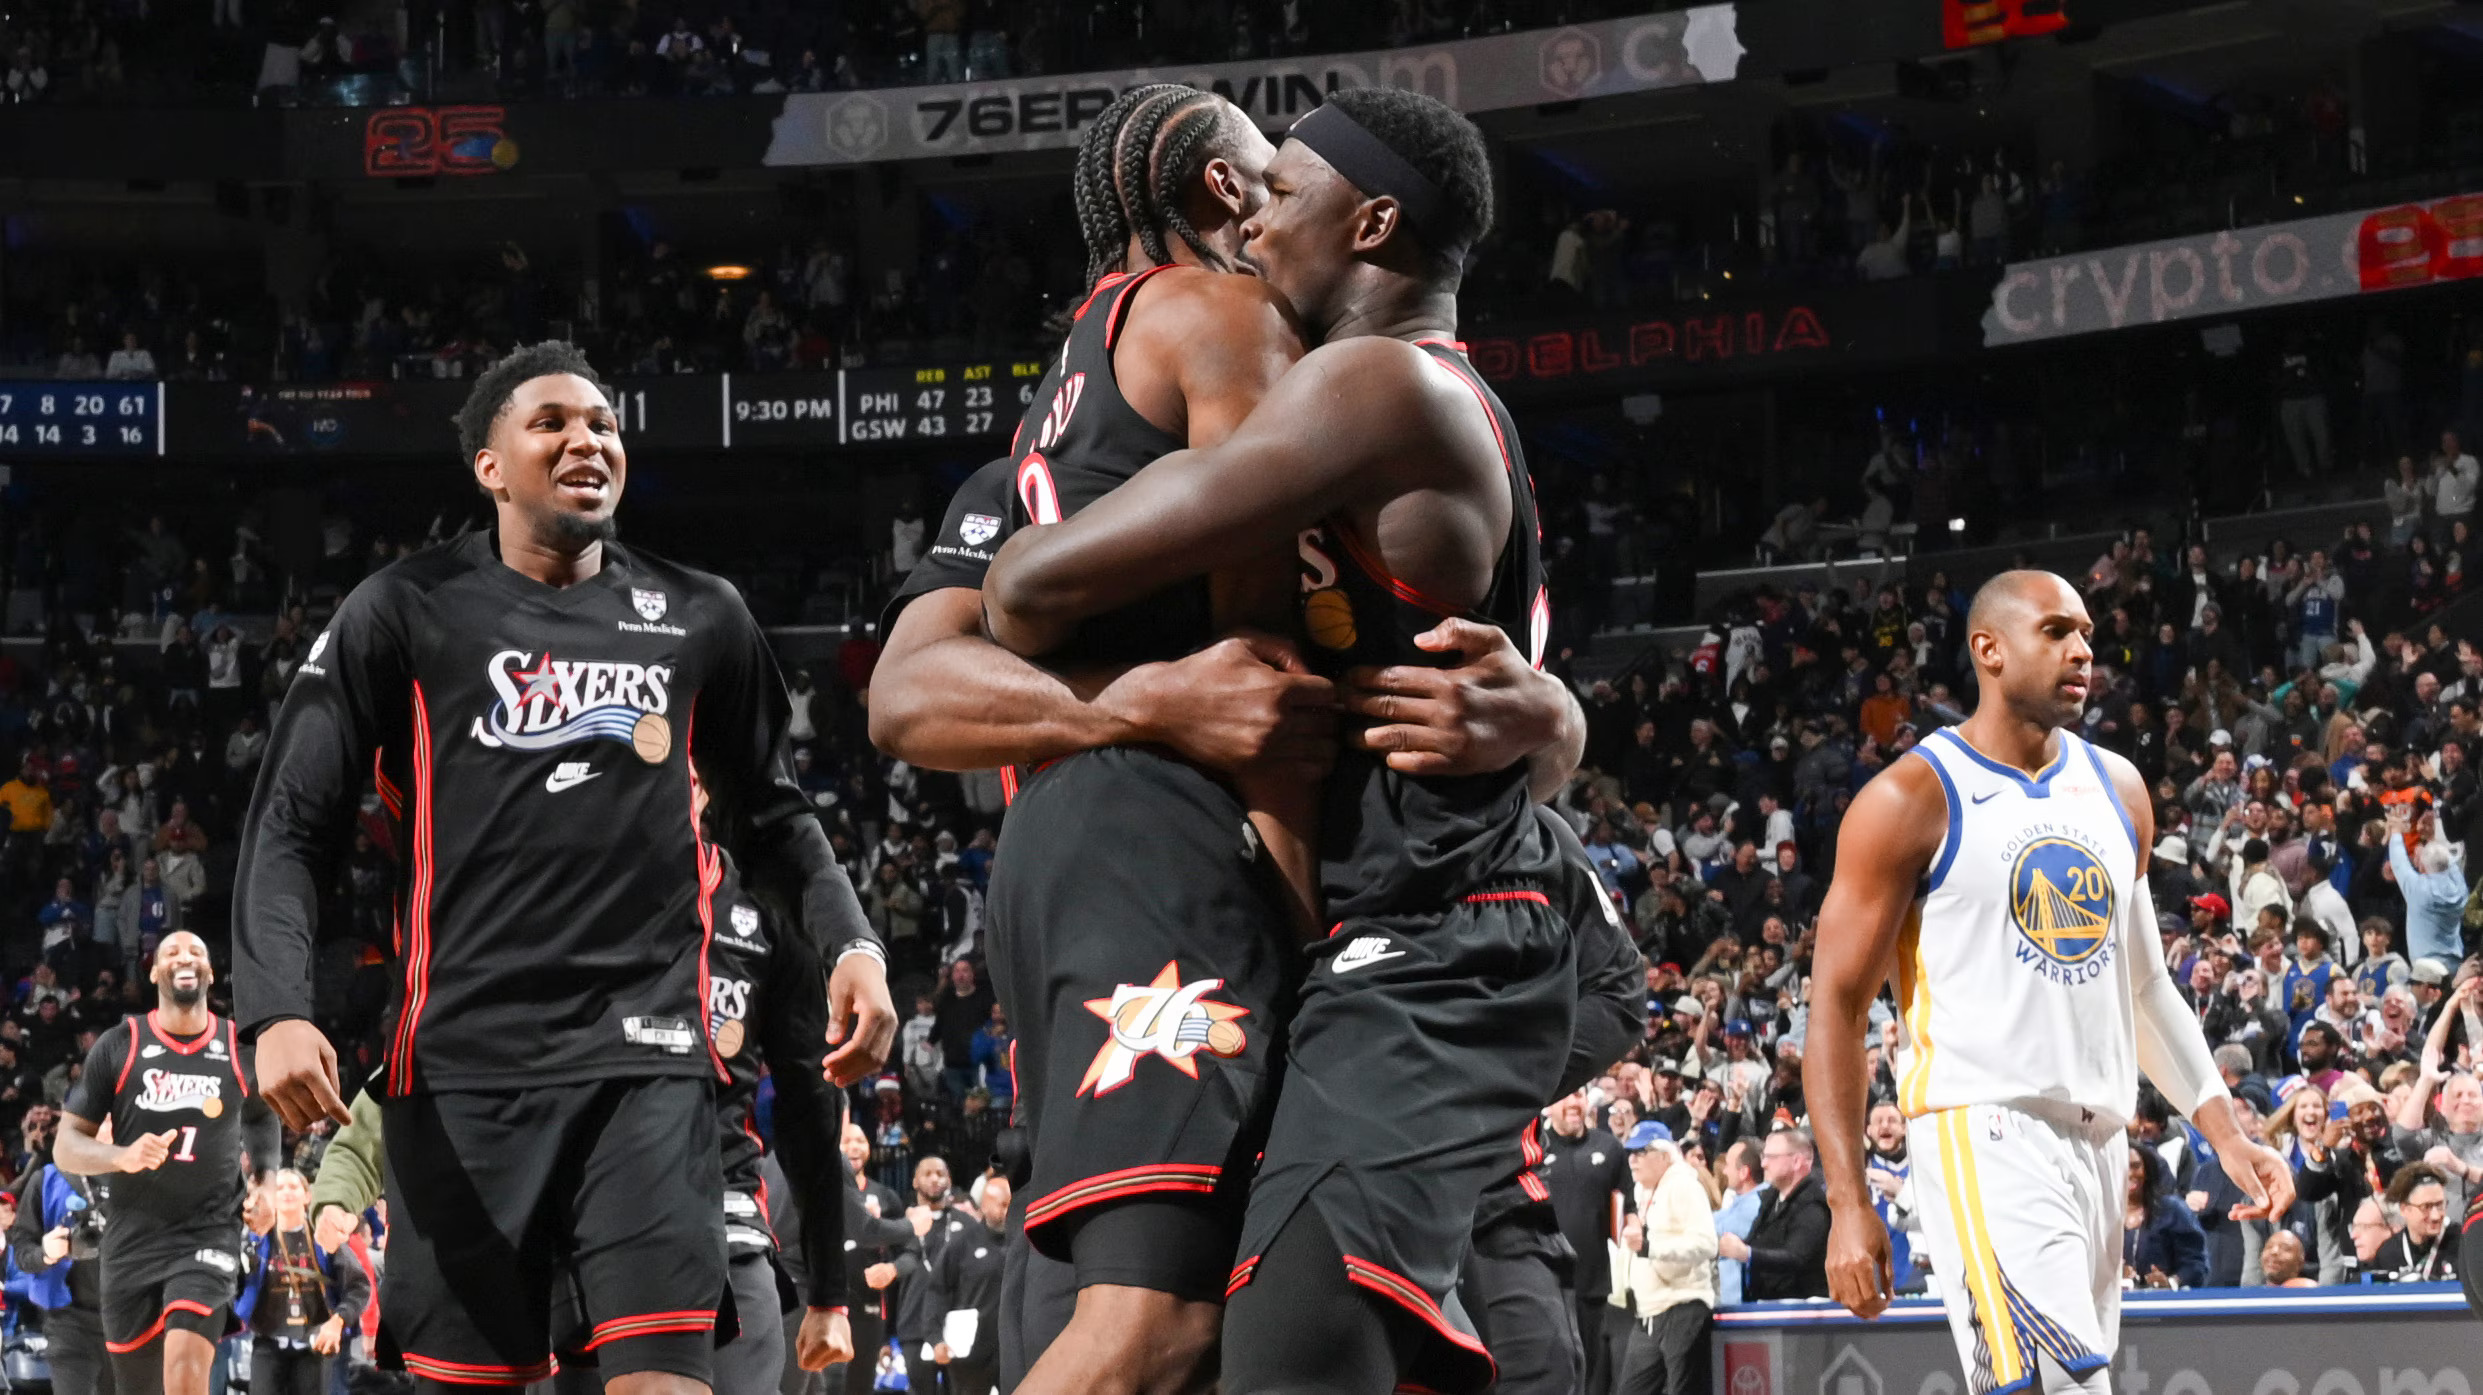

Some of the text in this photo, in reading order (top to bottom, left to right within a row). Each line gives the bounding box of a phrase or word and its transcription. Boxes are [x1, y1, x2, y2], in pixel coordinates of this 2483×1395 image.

[917, 88, 1119, 142] 76ER
[364, 104, 507, 178] 25
[916, 363, 1041, 383] REB AST BLK
[40, 394, 55, 415] 8
[74, 395, 105, 416] 20
[118, 395, 145, 416] 61
[736, 399, 832, 421] 9:30 PM
[860, 384, 1034, 414] PHI 47 23 6
[35, 424, 61, 444] 14
[82, 424, 96, 445] 3
[120, 426, 143, 444] 16
[852, 412, 993, 440] GSW 43 27
[957, 546, 994, 561] Medici
[617, 620, 687, 637] Penn Medicine
[471, 650, 672, 748] SIXERS
[2001, 822, 2108, 863] GOLDEN STATE
[2066, 865, 2105, 902] 20
[1343, 936, 1391, 960] NIKE
[2015, 936, 2117, 987] WARRIORS
[709, 975, 752, 1021] RS
[1097, 978, 1225, 1094] 76
[174, 1125, 197, 1162] 1
